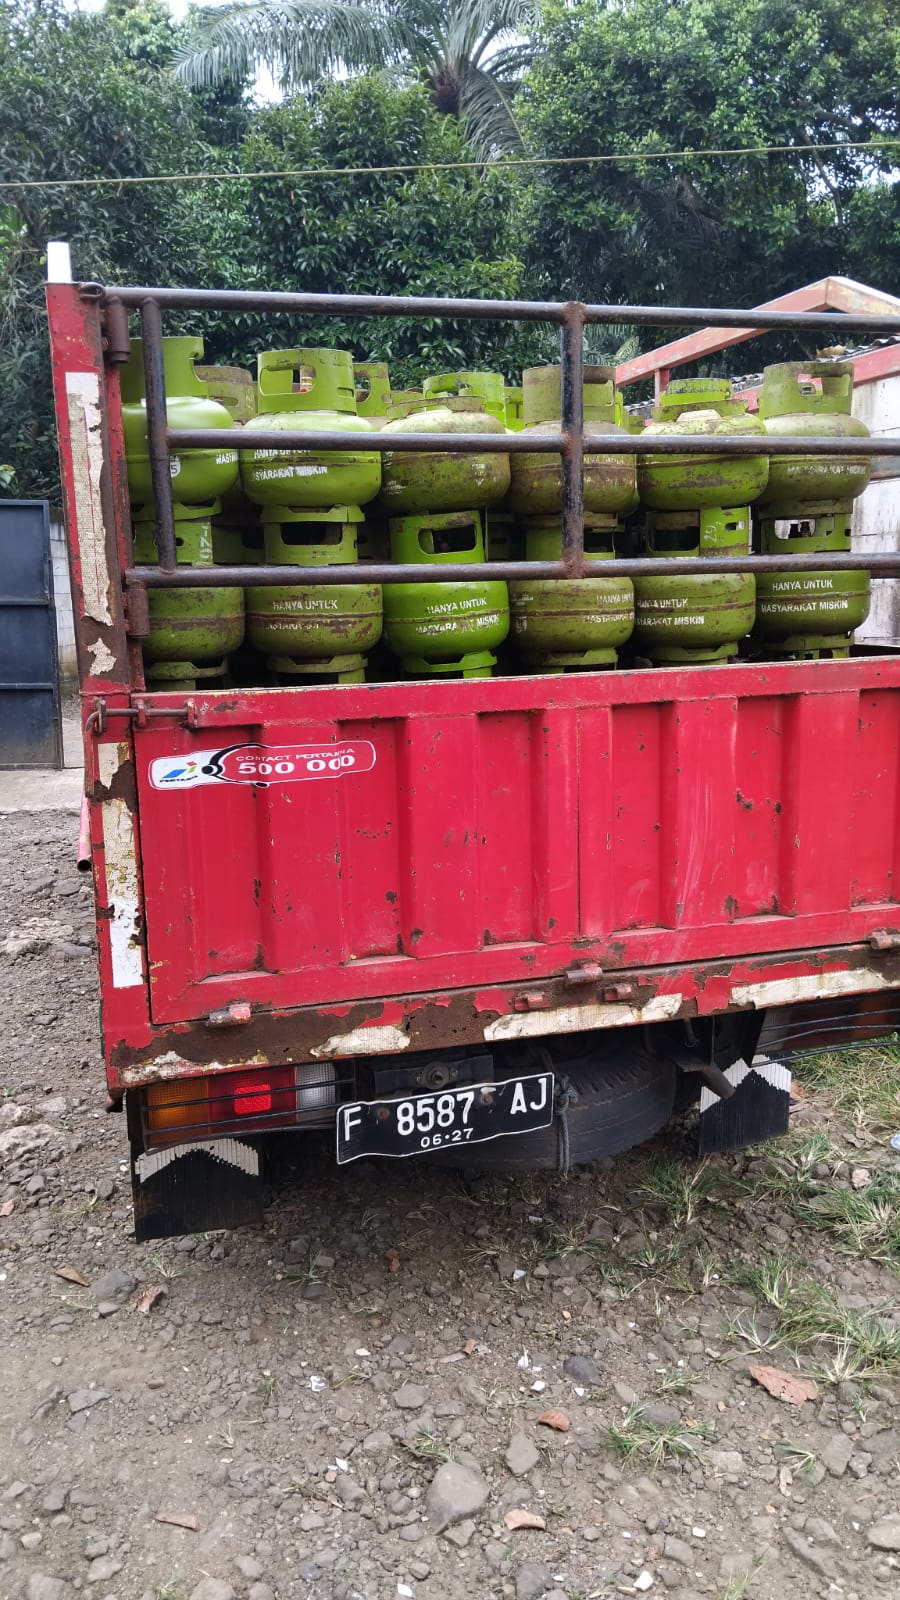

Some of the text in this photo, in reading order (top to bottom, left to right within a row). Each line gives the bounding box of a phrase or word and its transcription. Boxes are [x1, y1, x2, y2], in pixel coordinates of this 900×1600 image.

[772, 579, 833, 591] HANYA UNTUK
[273, 600, 338, 611] HANYA UNTUK
[427, 598, 487, 614] HANYA UNTUK
[660, 598, 688, 608] UNTUK
[761, 600, 849, 613] MASYARAKAT MISKIN
[416, 621, 474, 634] MASYARAAT
[674, 616, 705, 626] MISKIN
[238, 755, 356, 775] 500 000
[344, 1077, 548, 1142] F 8587 AJ
